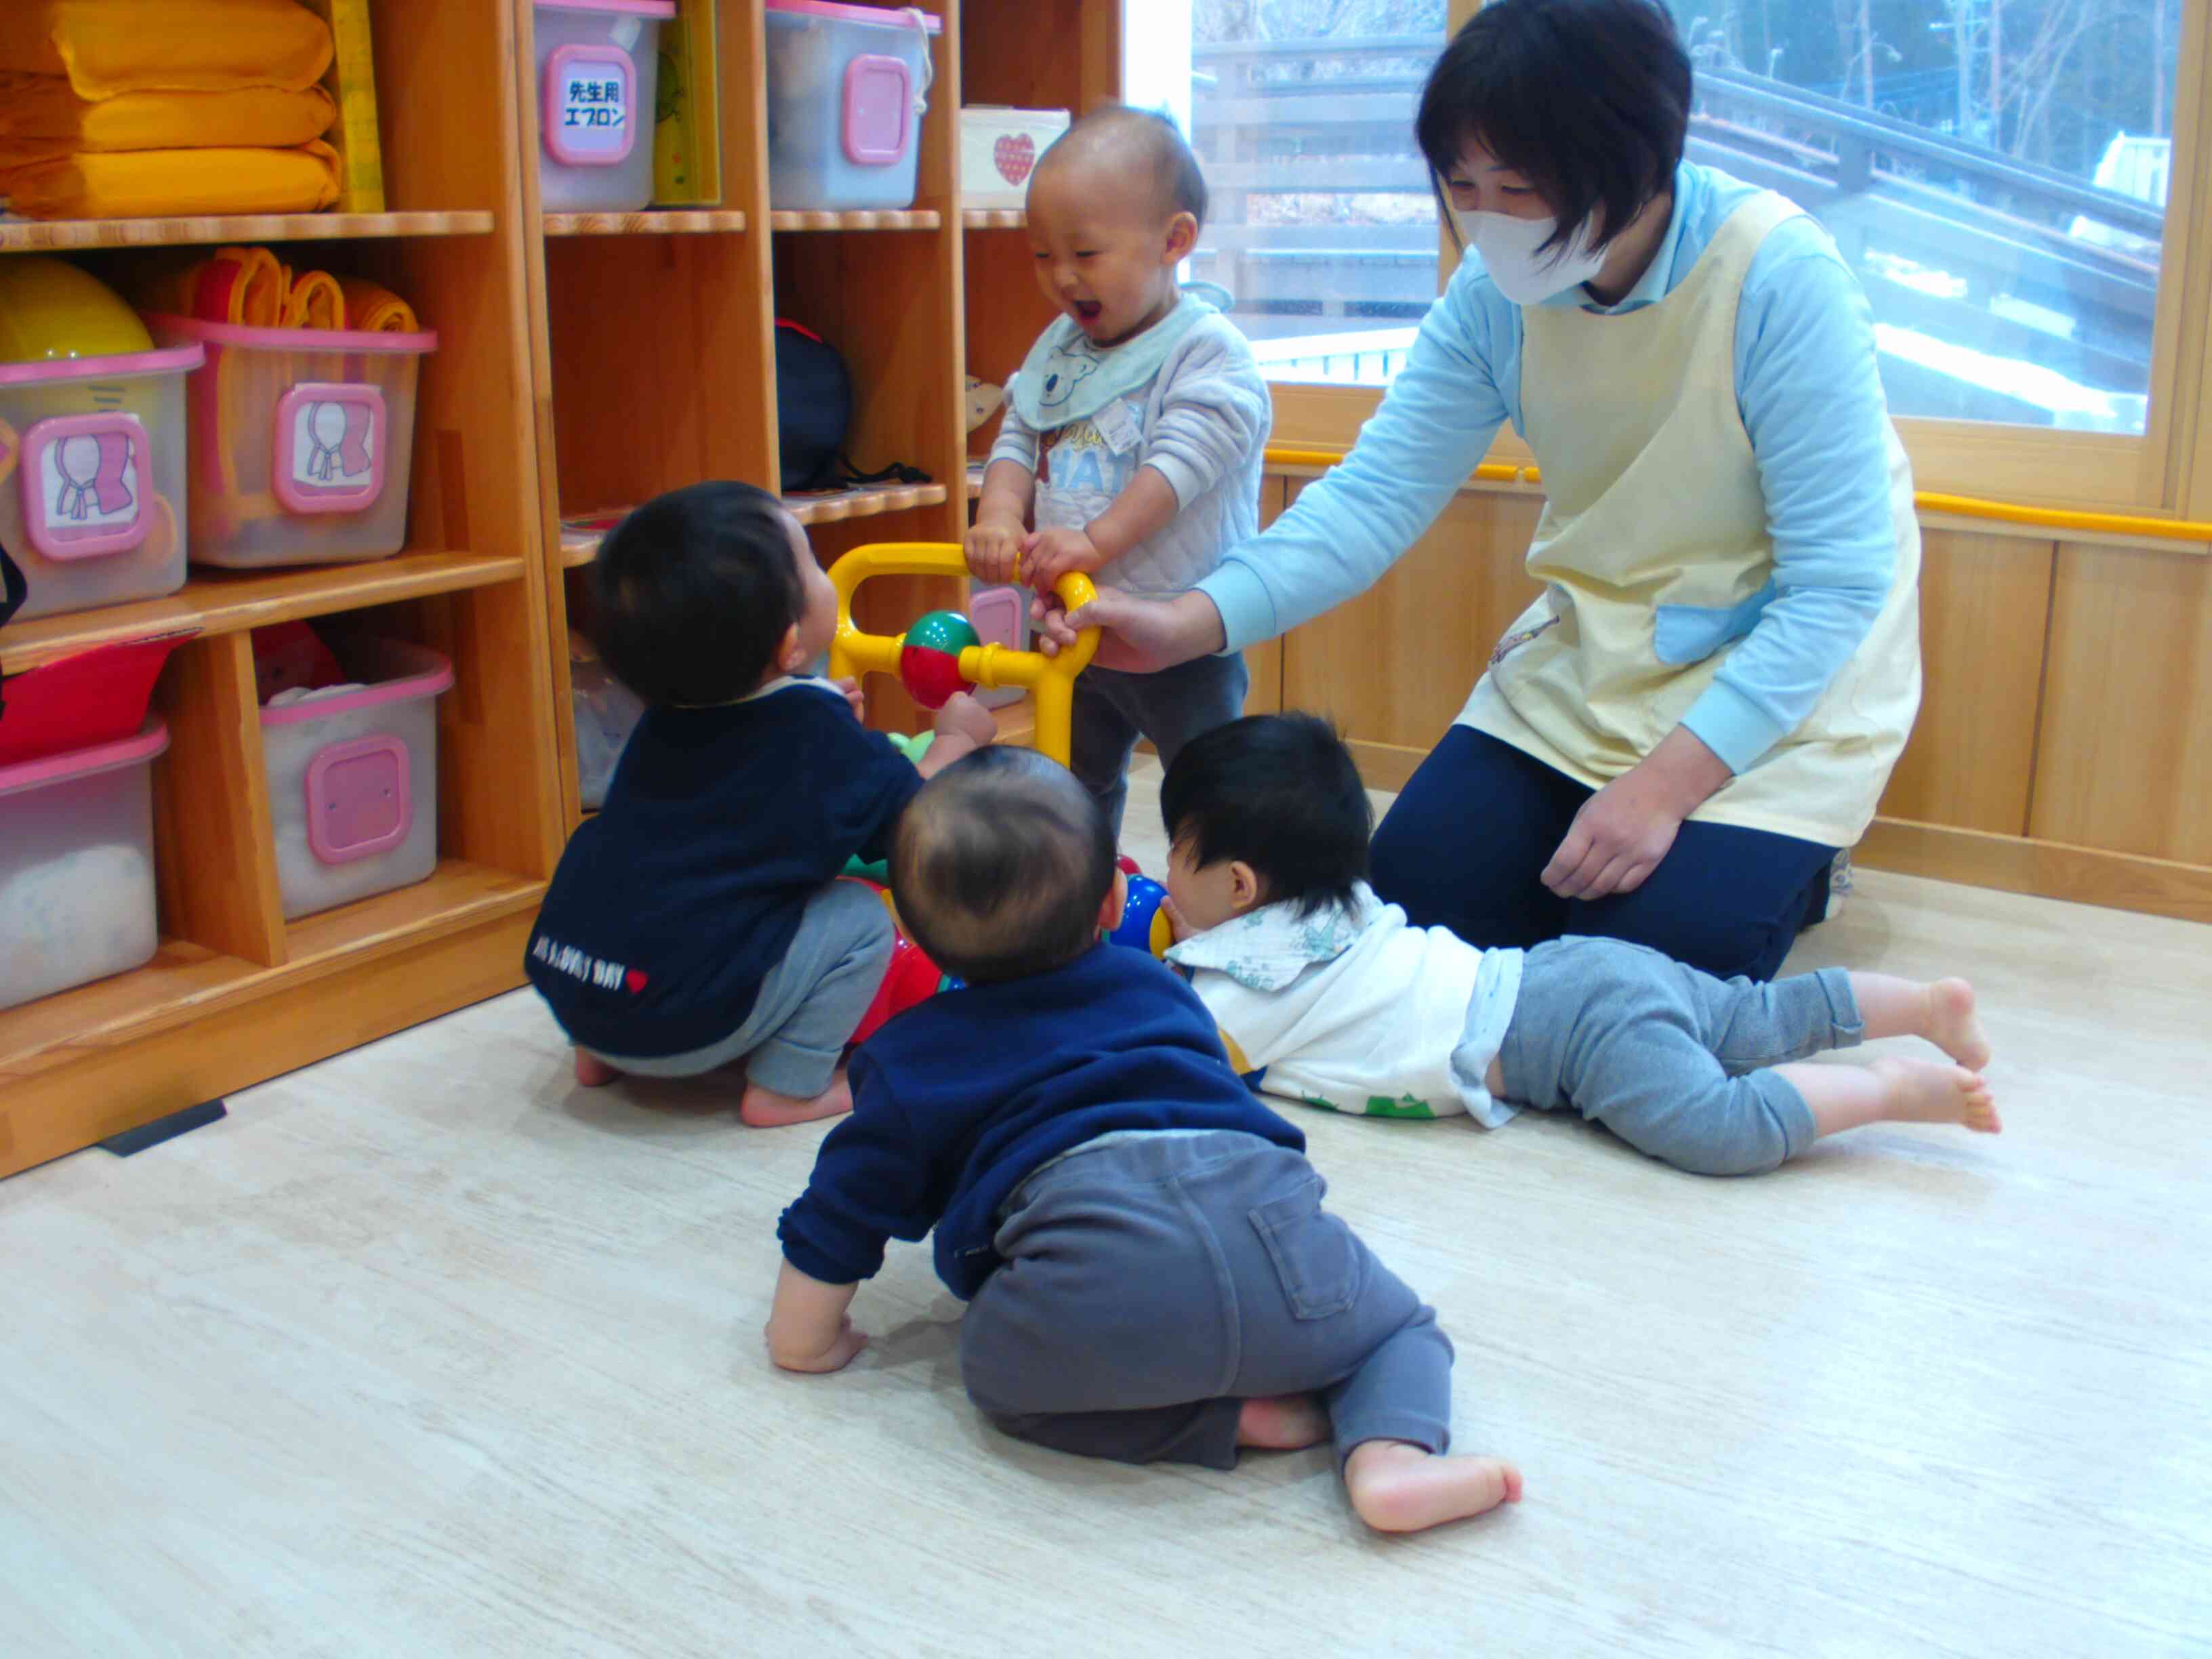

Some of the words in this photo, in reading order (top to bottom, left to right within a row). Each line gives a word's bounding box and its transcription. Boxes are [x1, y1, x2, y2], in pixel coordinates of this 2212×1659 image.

[570, 81, 619, 102] 先生用
[565, 107, 626, 127] エプロン
